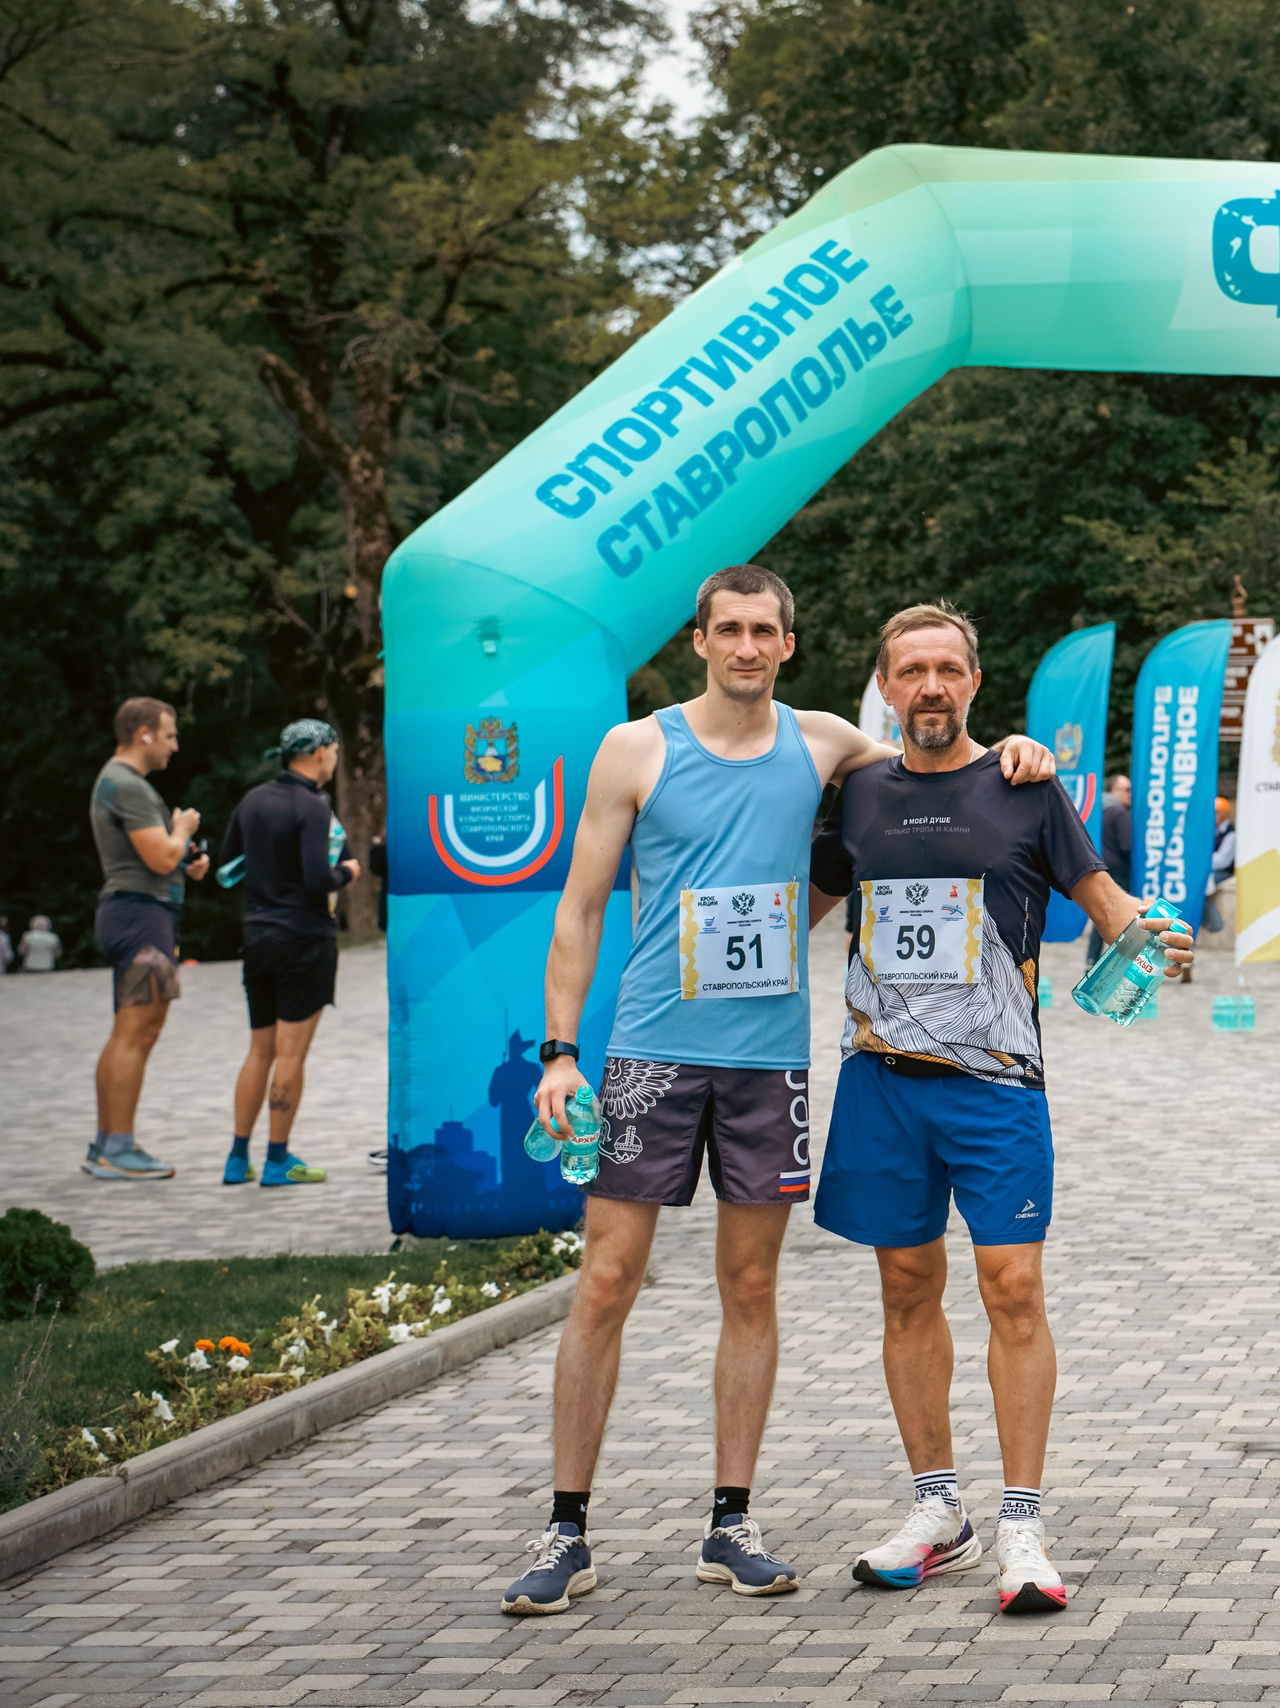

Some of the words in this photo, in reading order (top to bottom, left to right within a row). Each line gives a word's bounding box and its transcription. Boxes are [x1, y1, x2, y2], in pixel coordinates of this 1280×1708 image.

[535, 239, 870, 519] СПОРТИВНОЕ
[596, 284, 914, 579] СТАВРОПОЛЬЕ
[459, 792, 530, 802] МИНИСТЕРСТВО
[909, 816, 928, 825] МОЕЙ
[929, 816, 951, 825] ДУШЕ
[884, 828, 911, 836] ТОЛЬКО
[912, 826, 934, 834] ТРОПА
[943, 826, 971, 834] КАМНИ
[896, 924, 936, 960] 59
[726, 933, 763, 971] 51
[1135, 956, 1154, 973] РХЫЗ
[877, 971, 939, 981] СТАВРОПОЛЬСКИЙ
[940, 970, 959, 980] КРАЙ
[702, 979, 772, 991] СТАВРОПОЛЬСКИЙ
[772, 977, 789, 986] КРАЙ
[919, 1484, 950, 1493] TRAIL
